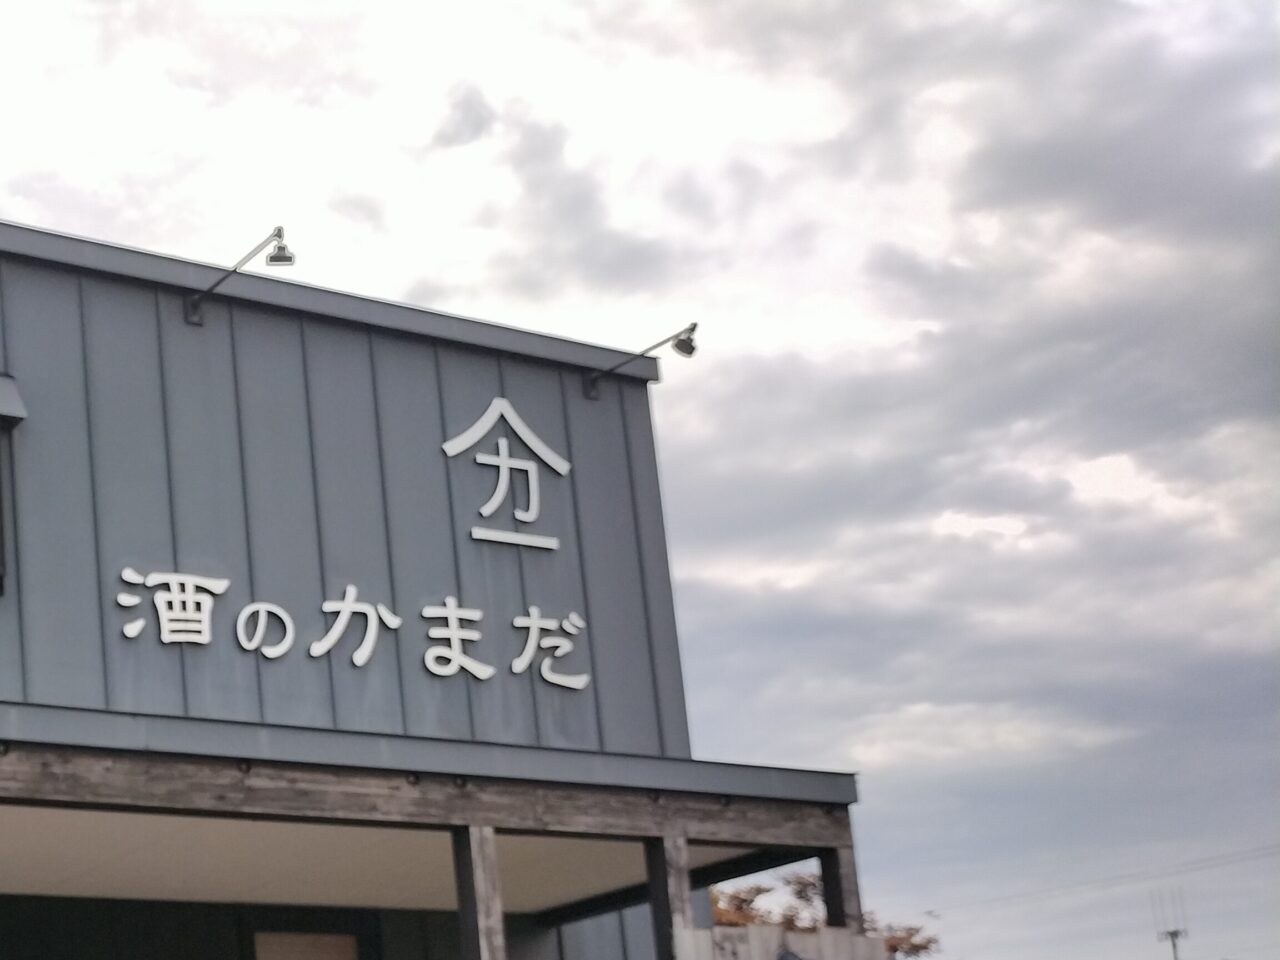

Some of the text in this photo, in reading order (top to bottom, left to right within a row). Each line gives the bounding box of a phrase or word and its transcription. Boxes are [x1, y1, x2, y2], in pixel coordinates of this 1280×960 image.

[117, 567, 590, 689] 酒のかまだ
